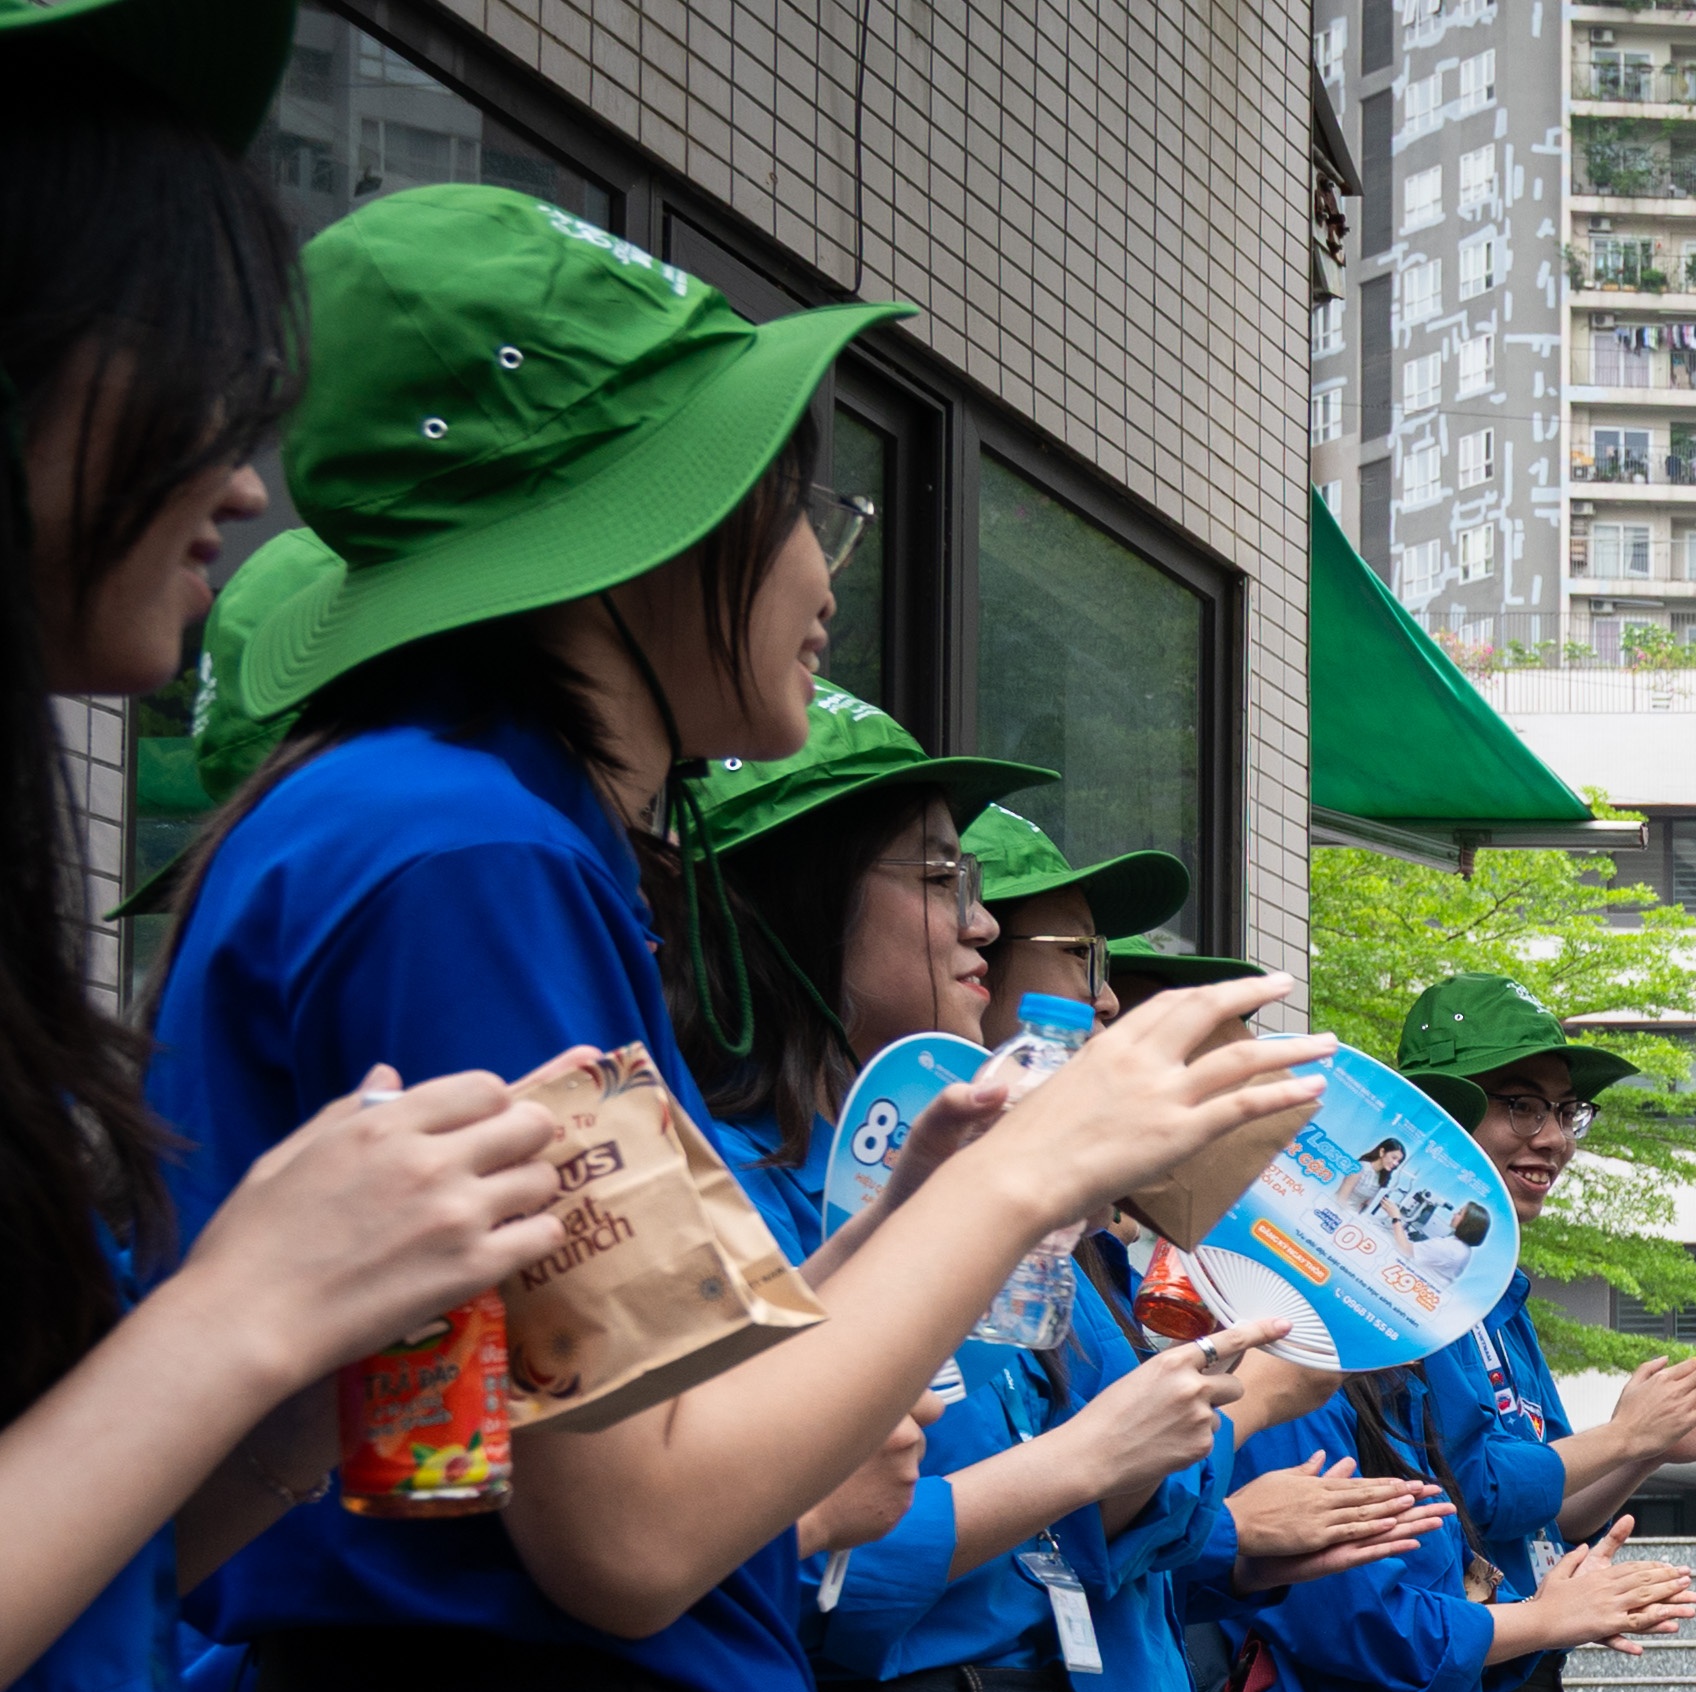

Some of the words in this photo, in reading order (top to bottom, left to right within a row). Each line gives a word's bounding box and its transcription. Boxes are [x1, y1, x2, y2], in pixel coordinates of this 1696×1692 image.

[852, 1098, 899, 1166] 8
[1306, 1130, 1362, 1173] Laser
[1298, 1152, 1335, 1182] cận
